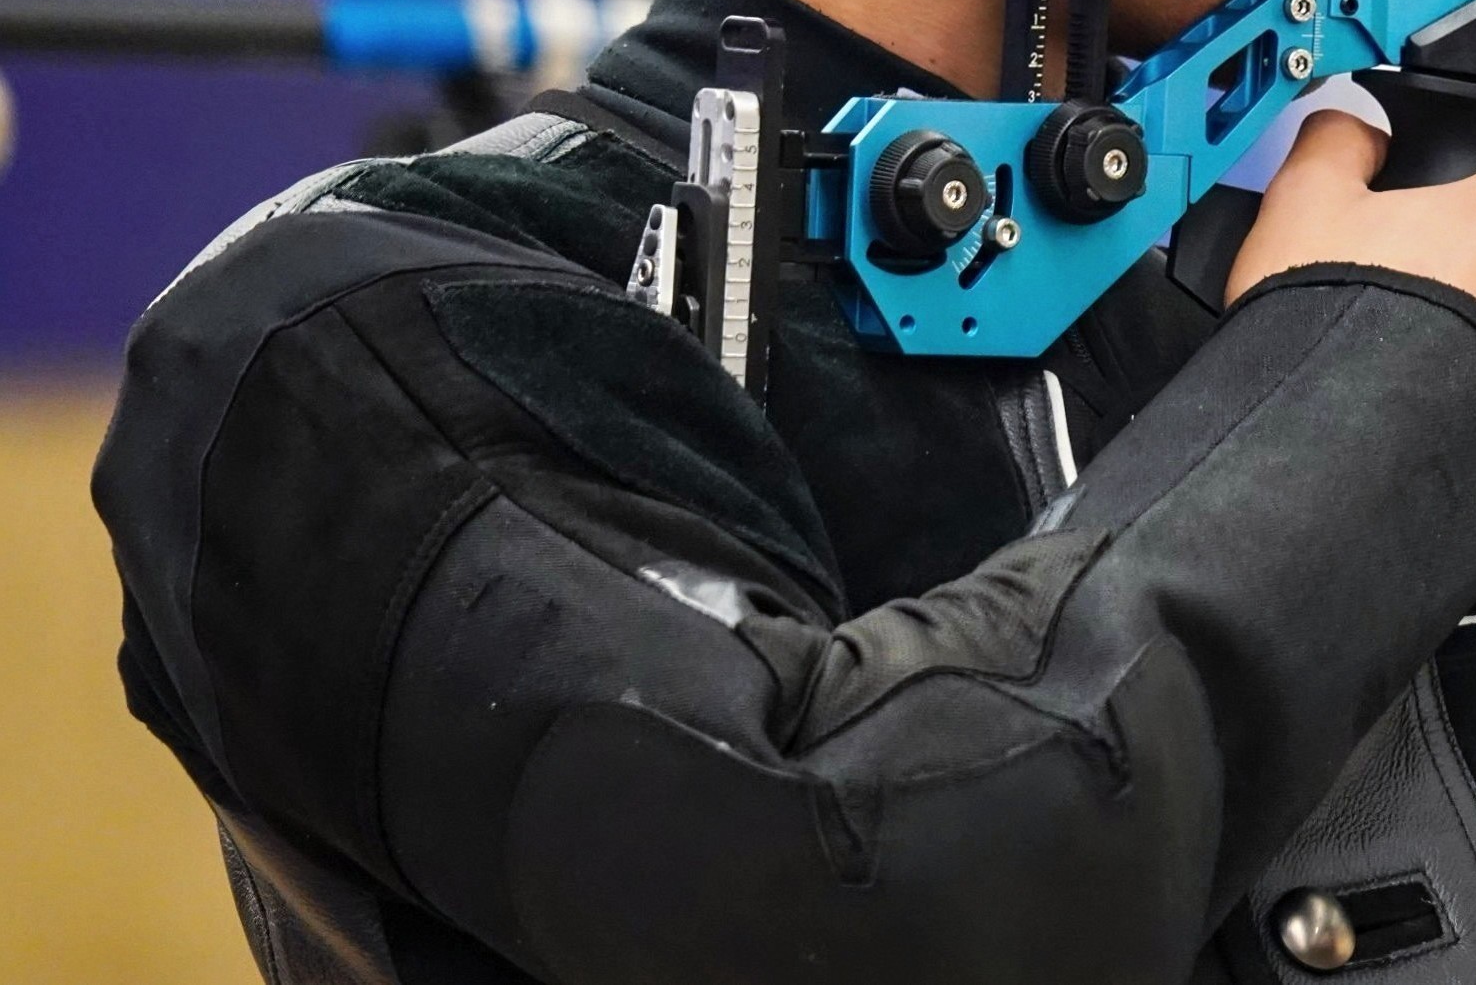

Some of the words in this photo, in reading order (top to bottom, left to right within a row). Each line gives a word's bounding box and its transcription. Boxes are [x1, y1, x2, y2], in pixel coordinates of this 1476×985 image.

[1033, 13, 1039, 26] 1
[1029, 52, 1038, 67] 2
[1027, 90, 1036, 103] 3
[745, 144, 757, 155] 5
[743, 182, 756, 192] 4
[741, 220, 753, 231] 3
[738, 257, 751, 268] 2
[735, 332, 747, 343] 0
